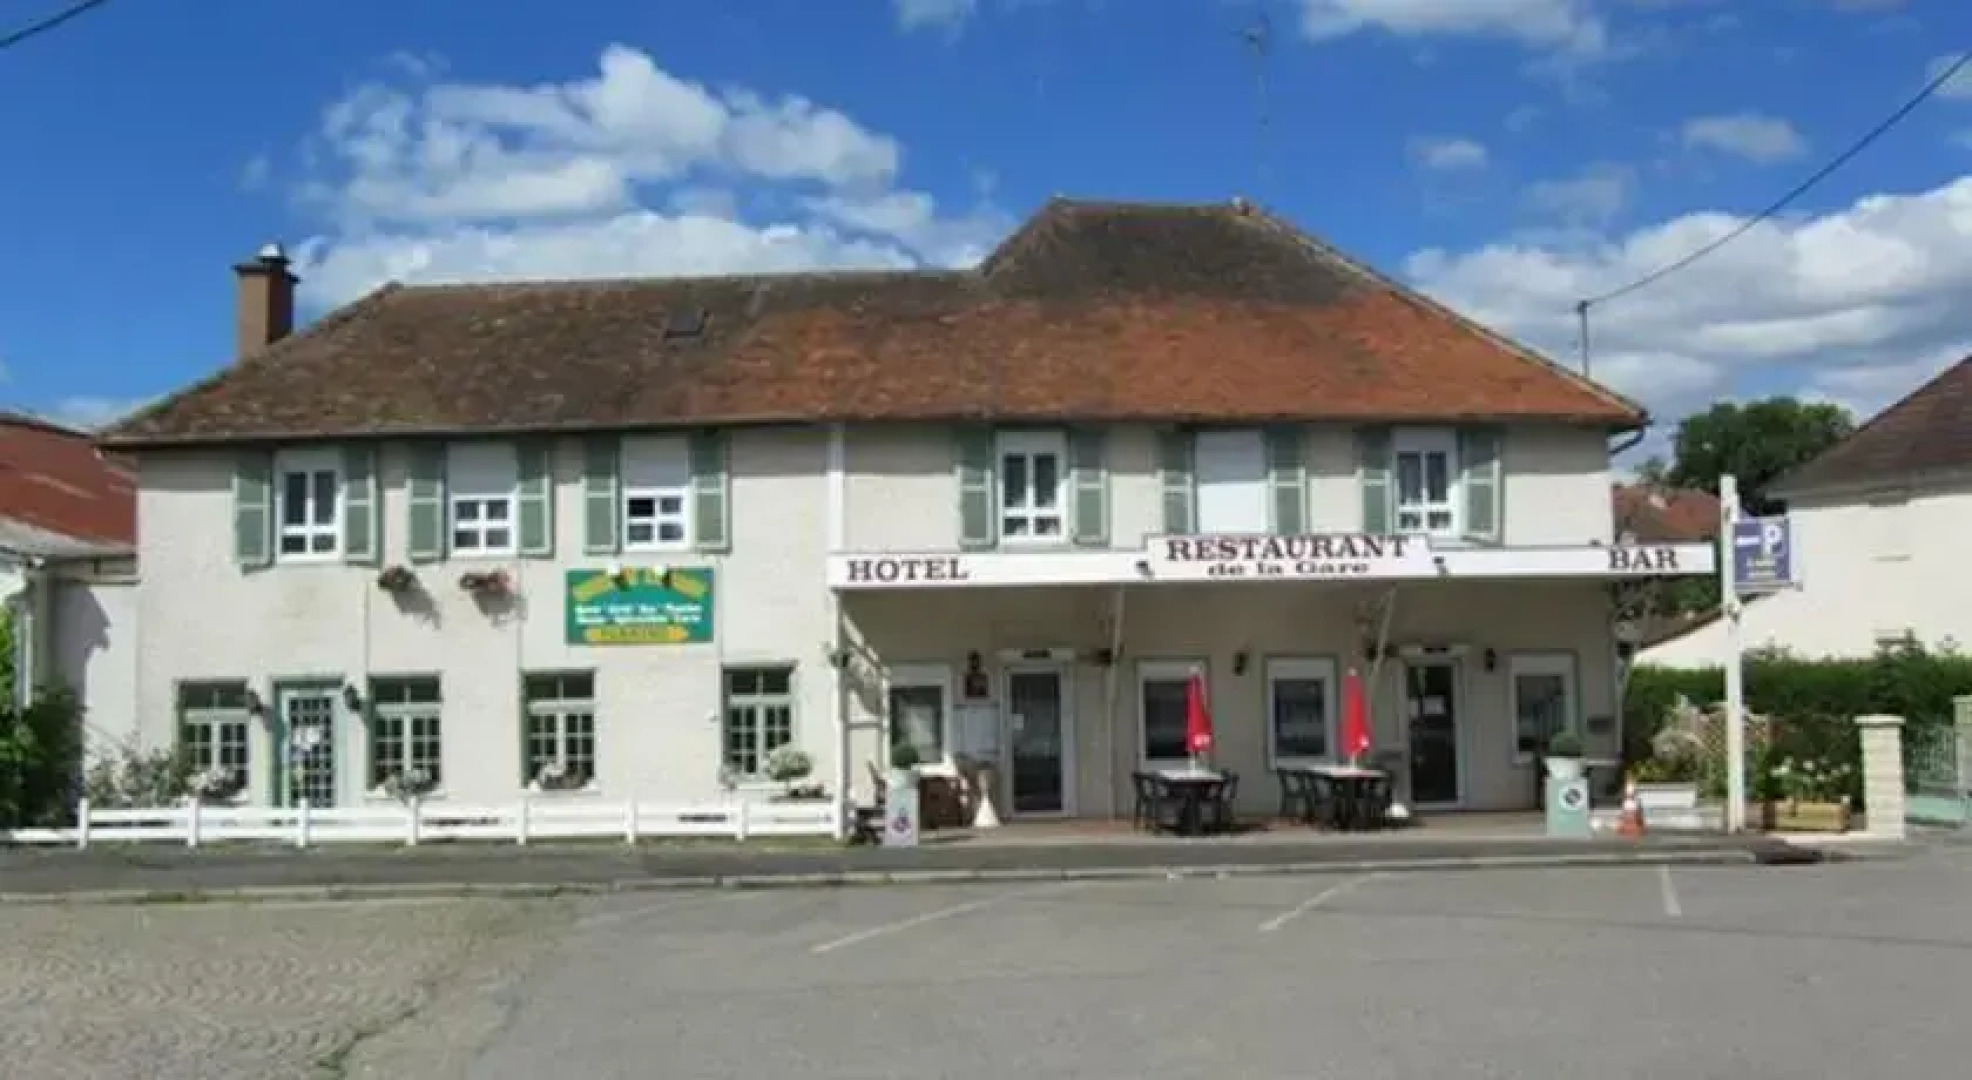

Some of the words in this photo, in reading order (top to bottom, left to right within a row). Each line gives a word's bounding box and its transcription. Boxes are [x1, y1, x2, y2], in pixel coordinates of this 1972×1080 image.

[1166, 534, 1408, 561] RESTAURANT
[1608, 548, 1678, 569] BAR
[846, 558, 970, 582] HOTEL
[1207, 562, 1244, 576] de
[1257, 562, 1284, 575] la
[1295, 561, 1369, 574] Gare
